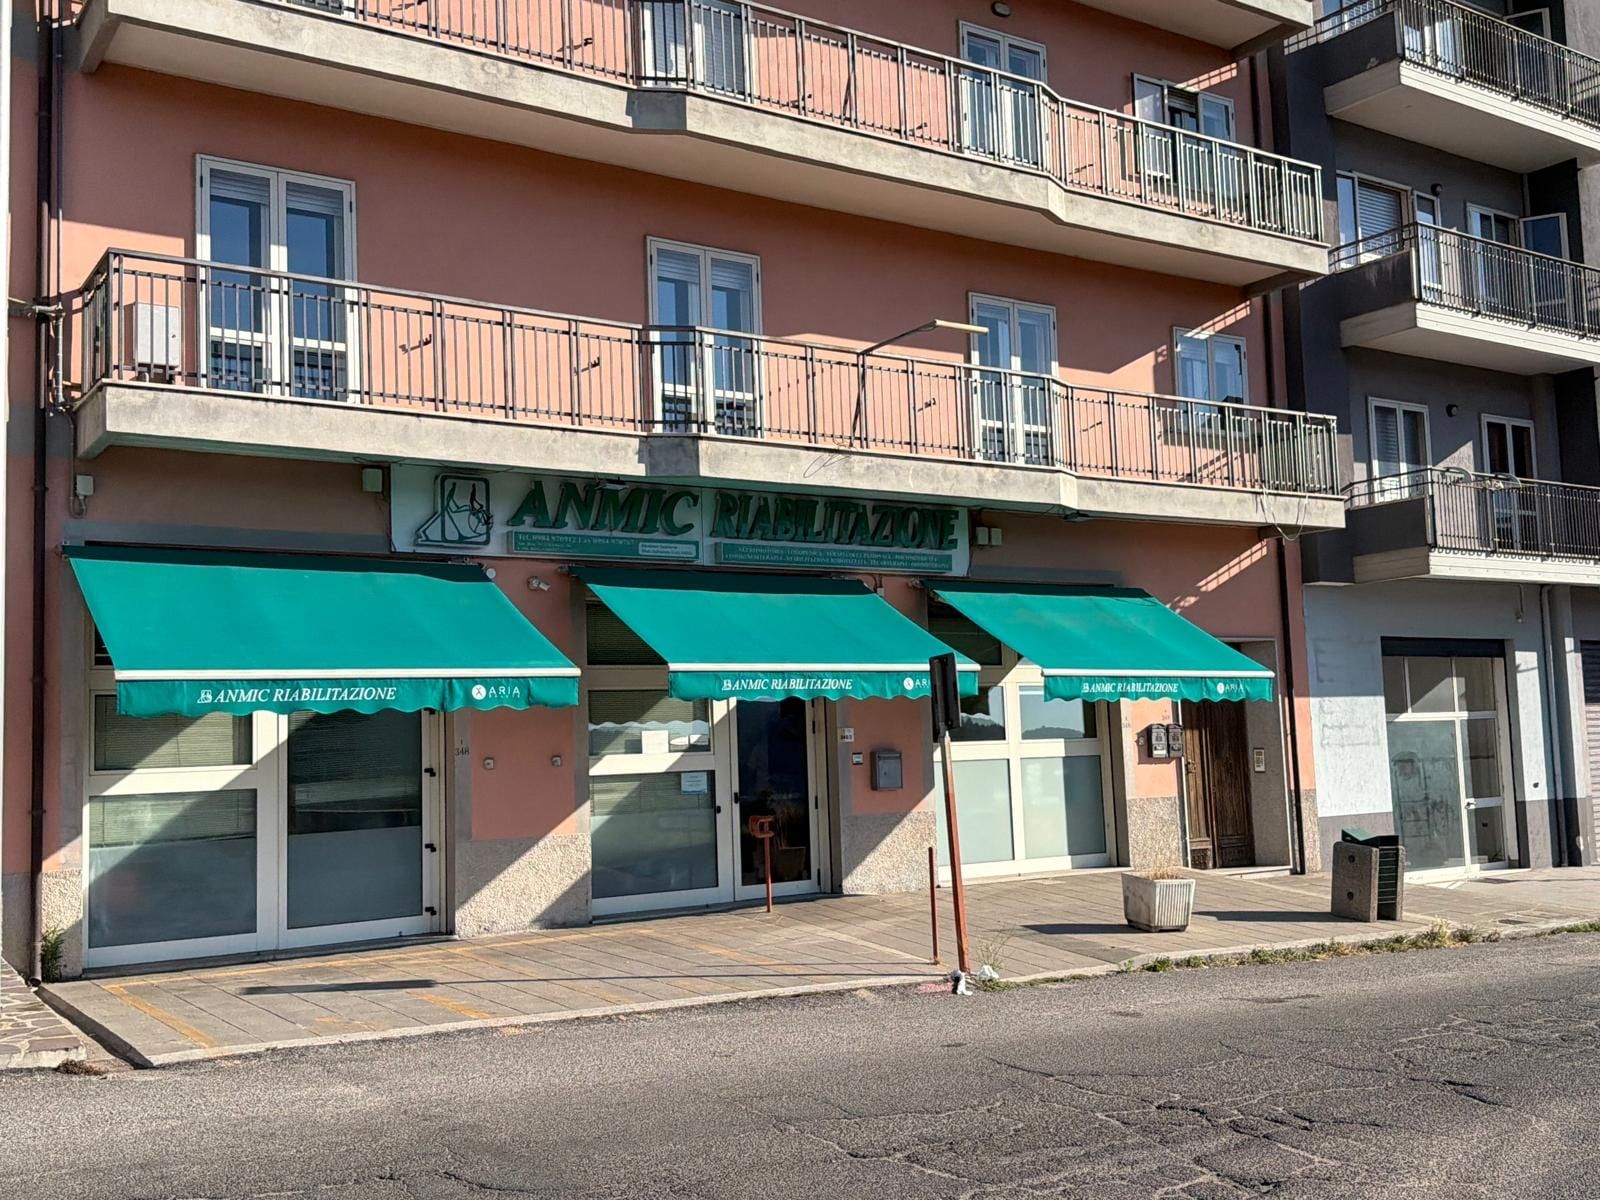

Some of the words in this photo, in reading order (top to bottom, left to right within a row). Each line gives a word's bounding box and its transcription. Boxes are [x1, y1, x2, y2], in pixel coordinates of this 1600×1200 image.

[506, 479, 700, 536] ANMIC
[709, 489, 960, 550] RIABILITAZIONE
[732, 679, 770, 690] ANMIC
[771, 678, 853, 690] RIABILITAZIONE
[1089, 682, 1116, 693] ANMIC
[214, 688, 270, 703] ANMIC
[272, 687, 397, 702] RIABILITAZIONE
[488, 686, 521, 699] ARIA
